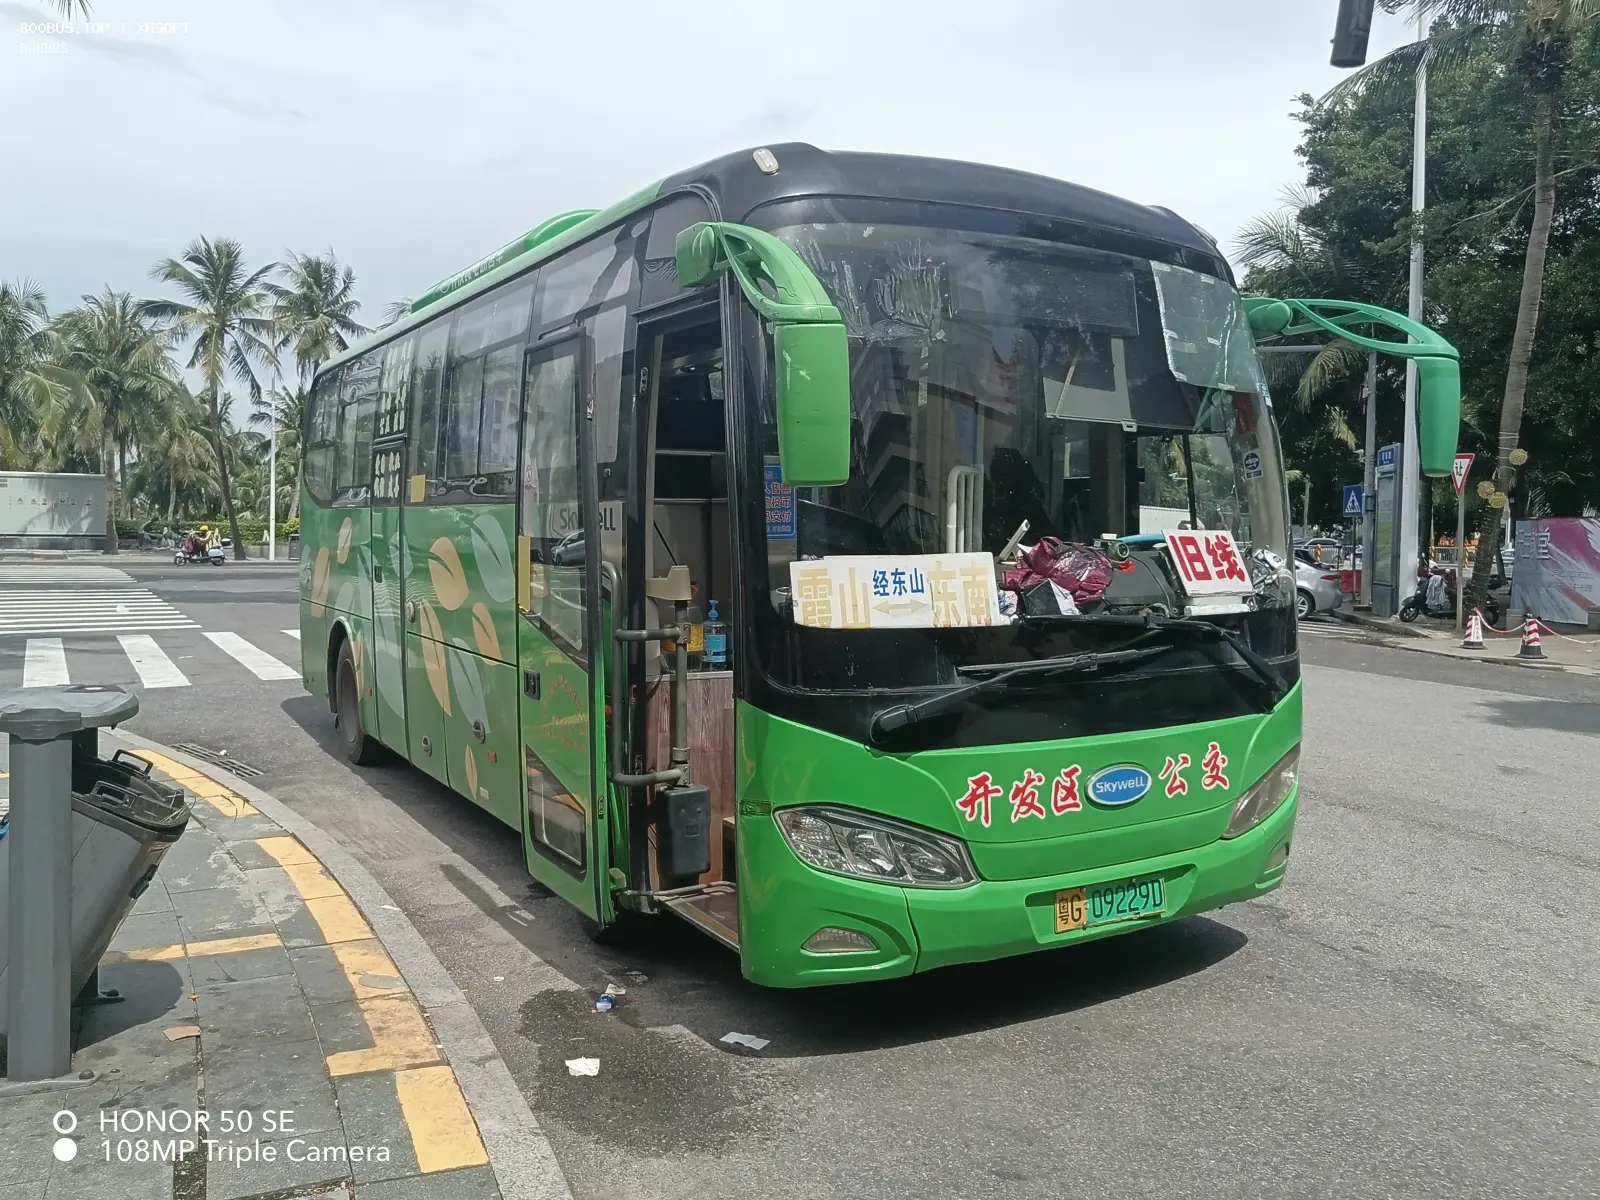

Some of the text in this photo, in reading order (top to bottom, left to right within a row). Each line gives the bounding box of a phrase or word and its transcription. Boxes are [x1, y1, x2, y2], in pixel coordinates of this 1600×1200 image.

[1454, 460, 1464, 477] 让
[1168, 534, 1246, 582] 旧线
[872, 567, 925, 597] 经东山
[927, 559, 992, 627] 东南
[955, 741, 1230, 828] 开发区 公交
[1095, 776, 1146, 795] Skywell
[1058, 878, 1163, 925] 粤G 09229D
